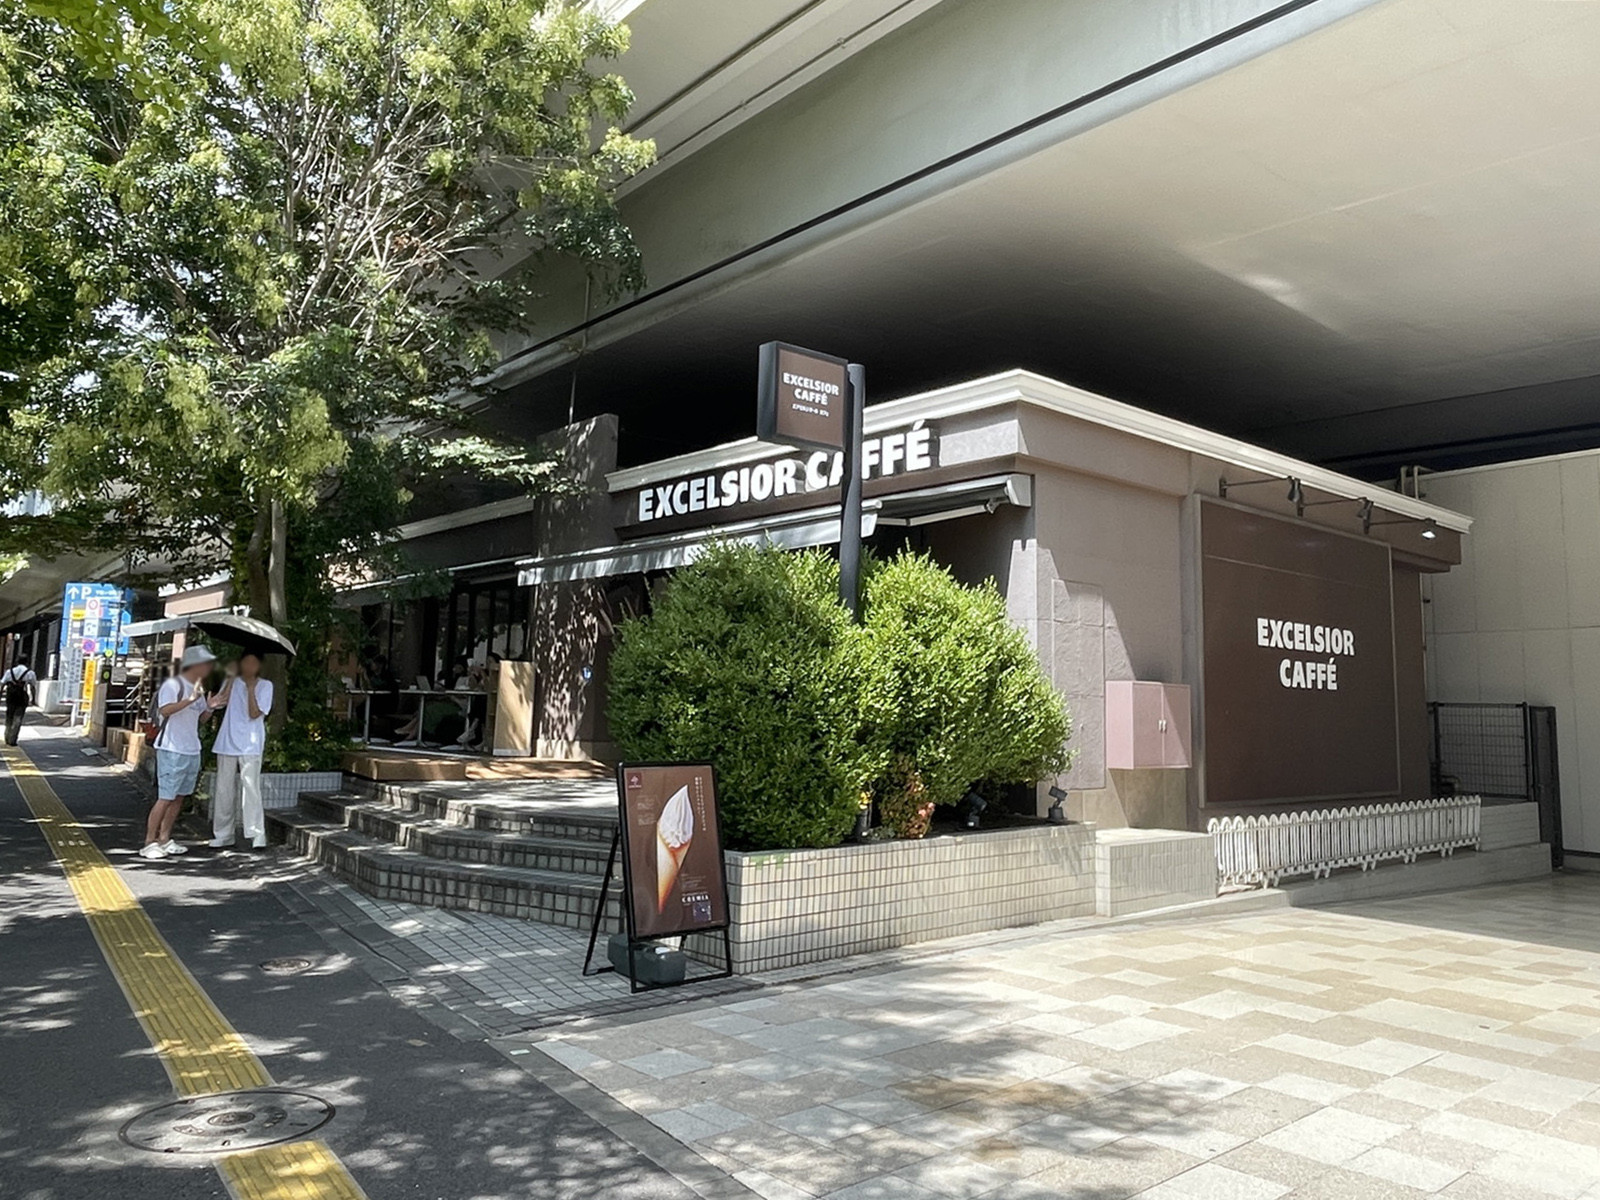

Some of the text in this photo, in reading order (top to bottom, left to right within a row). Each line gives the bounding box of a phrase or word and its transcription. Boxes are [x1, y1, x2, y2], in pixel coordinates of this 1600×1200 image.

[783, 372, 839, 396] EXCELSIOR
[794, 388, 829, 406] CAFFÉ
[638, 458, 797, 522] EXCELSIOR
[81, 586, 92, 600] P
[1257, 617, 1355, 656] EXCELSIOR
[1279, 657, 1338, 691] CAFFÉ
